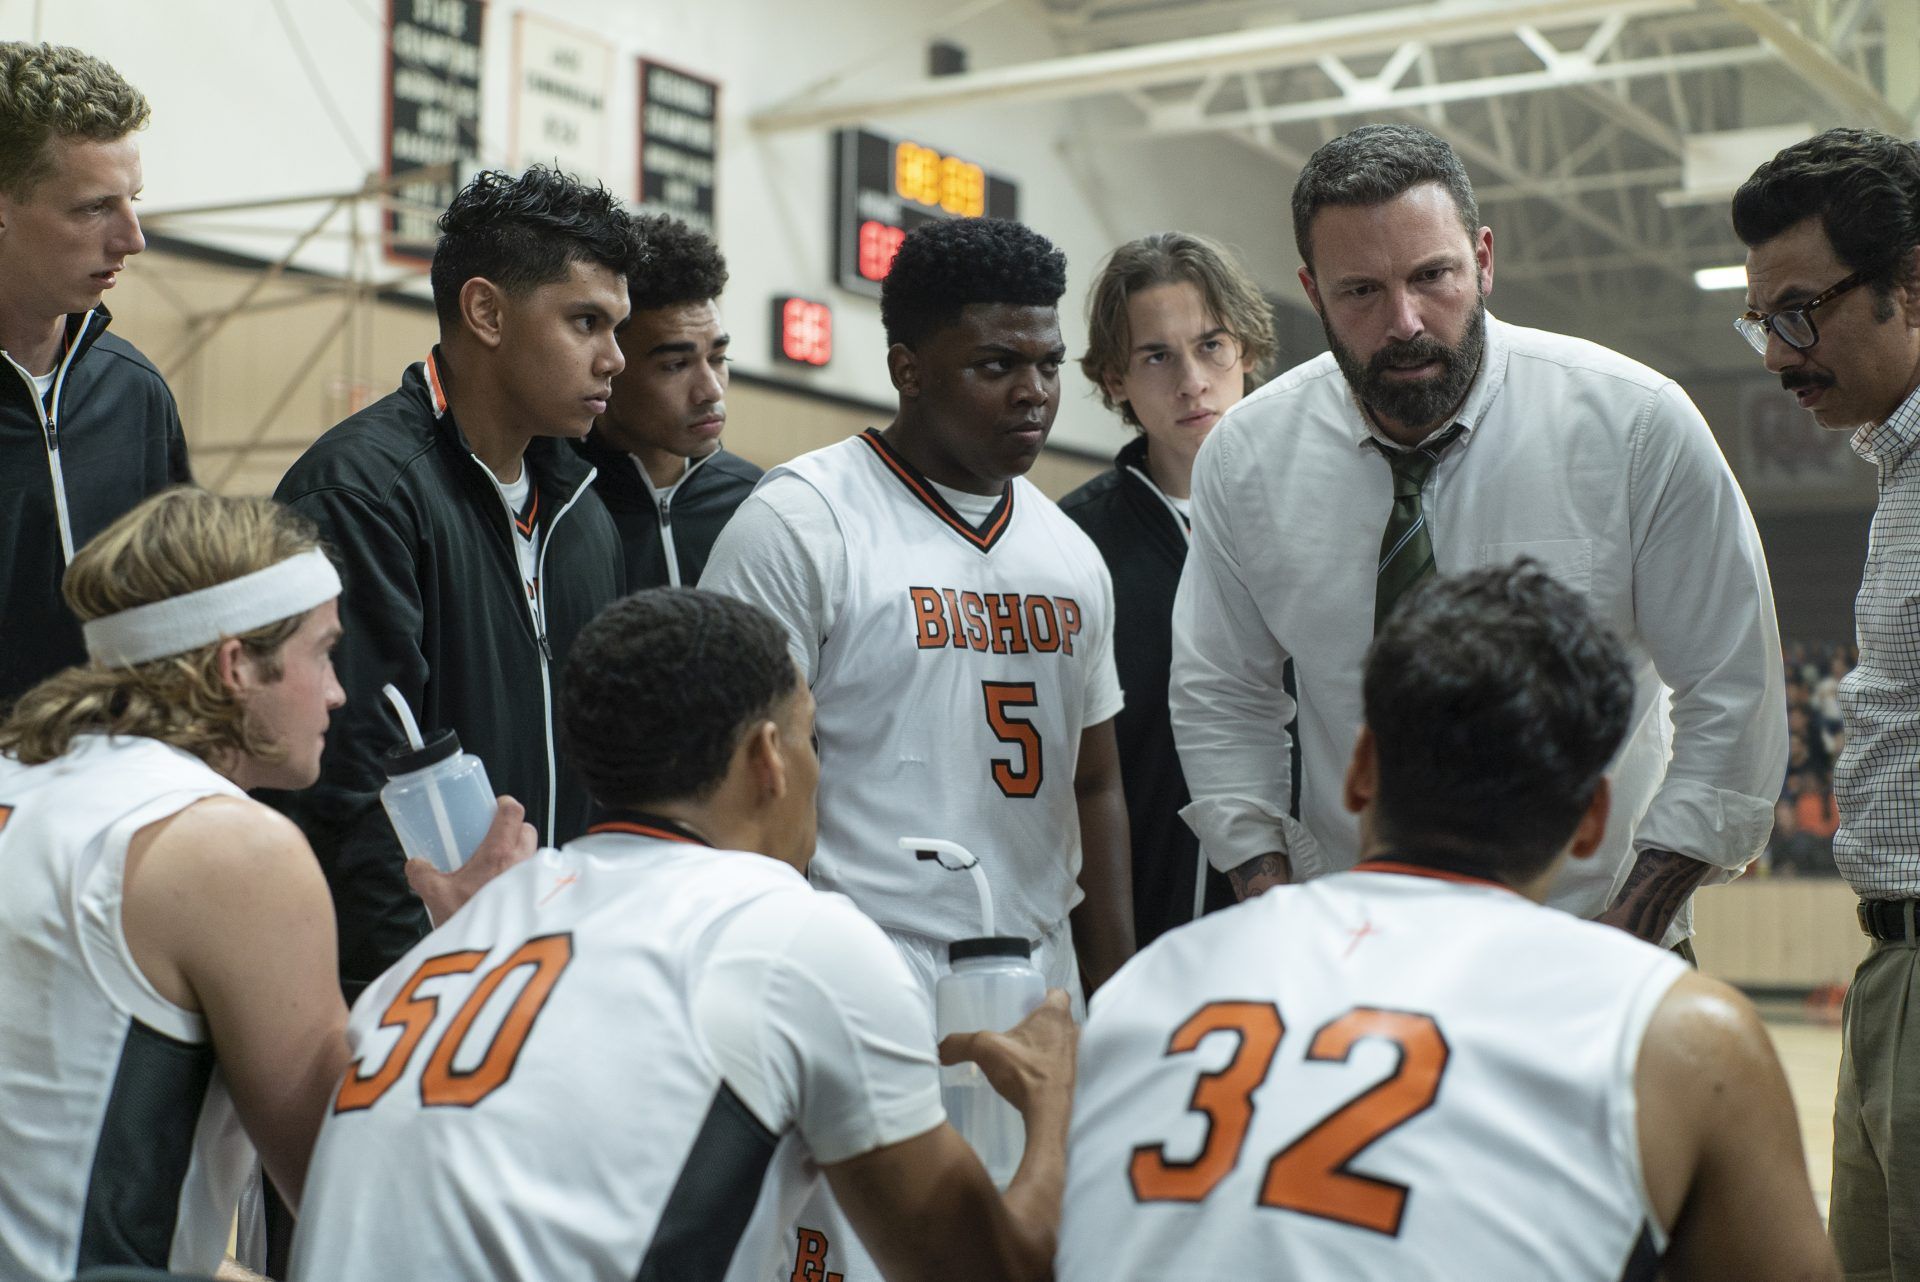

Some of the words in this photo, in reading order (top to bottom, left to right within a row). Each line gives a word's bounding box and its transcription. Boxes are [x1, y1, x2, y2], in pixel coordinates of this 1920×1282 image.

[909, 586, 1081, 656] BISHOP
[981, 680, 1044, 798] 5
[333, 931, 575, 1116] 50
[1128, 1000, 1452, 1238] 32
